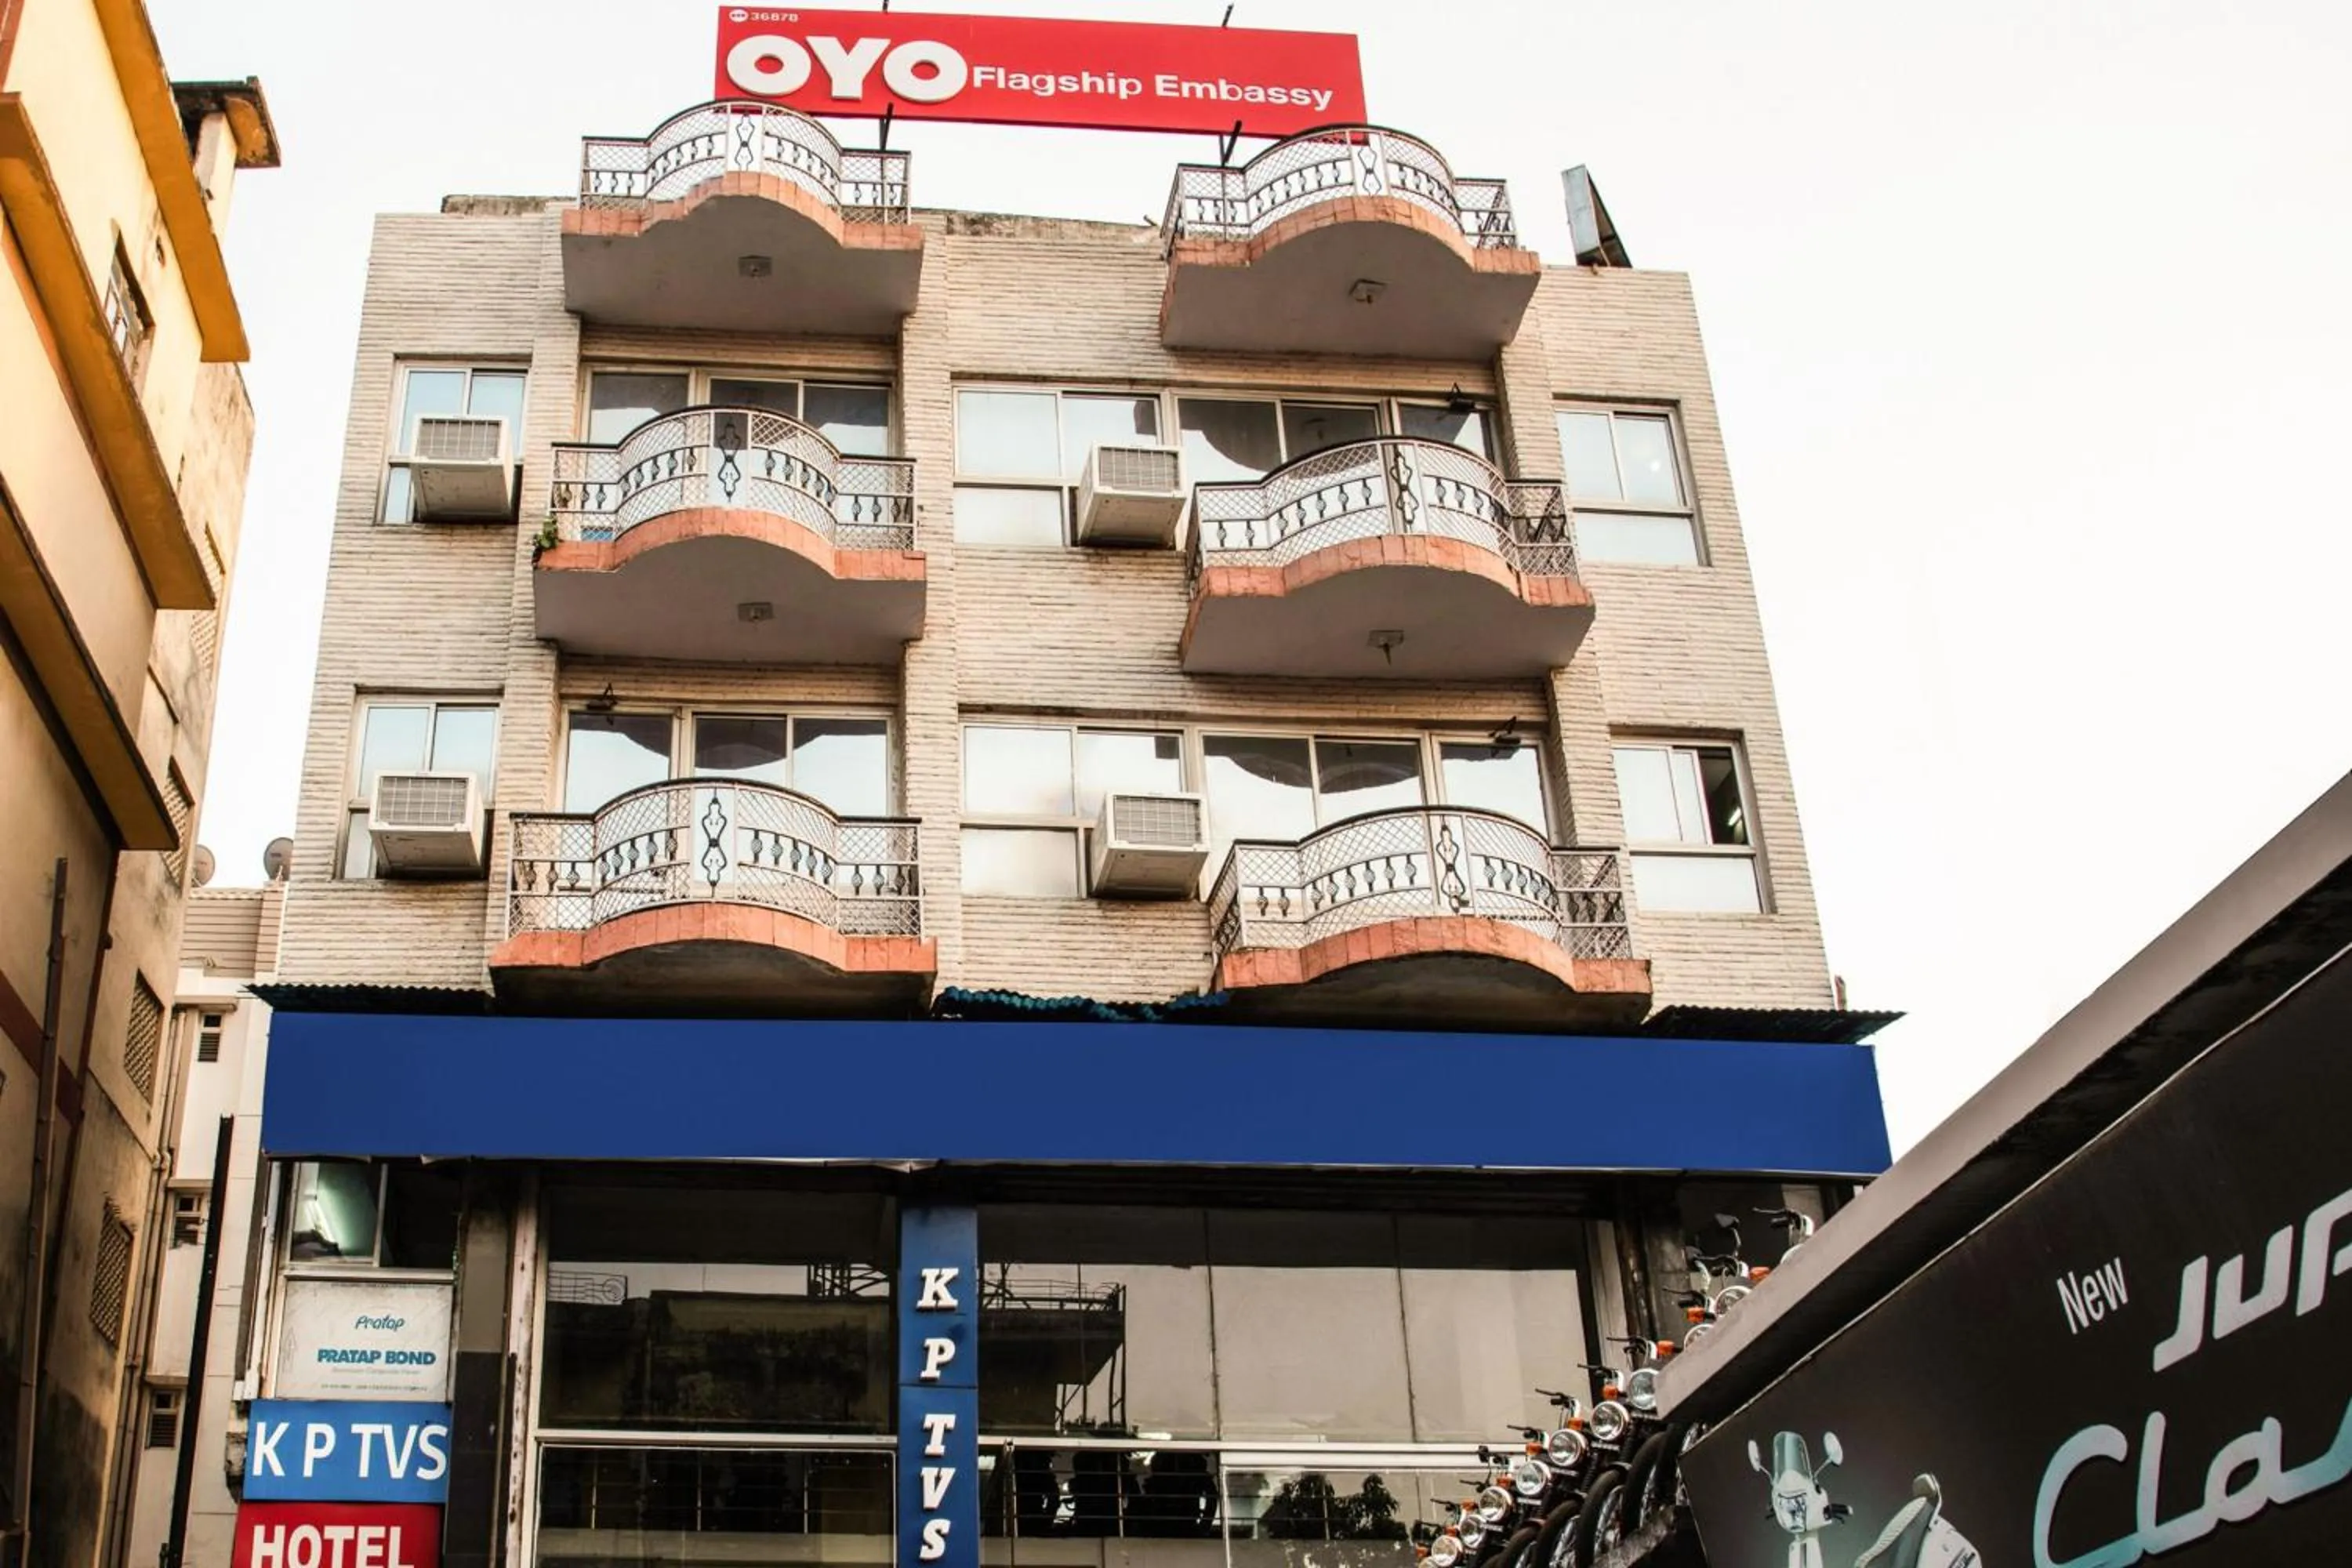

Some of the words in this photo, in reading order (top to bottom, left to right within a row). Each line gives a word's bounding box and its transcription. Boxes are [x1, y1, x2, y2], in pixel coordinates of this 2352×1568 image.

[726, 34, 968, 103] OYO
[972, 64, 1143, 96] Flagship
[1154, 74, 1333, 111] Embassy
[354, 1314, 405, 1332] Pratap
[2057, 1257, 2129, 1334] New
[317, 1348, 381, 1364] PRATAP
[385, 1351, 437, 1365] BOND
[252, 1421, 290, 1477] K
[303, 1422, 336, 1478] P
[350, 1423, 448, 1480] TVS
[919, 1414, 956, 1560] TVS
[250, 1523, 415, 1568] HOTEL
